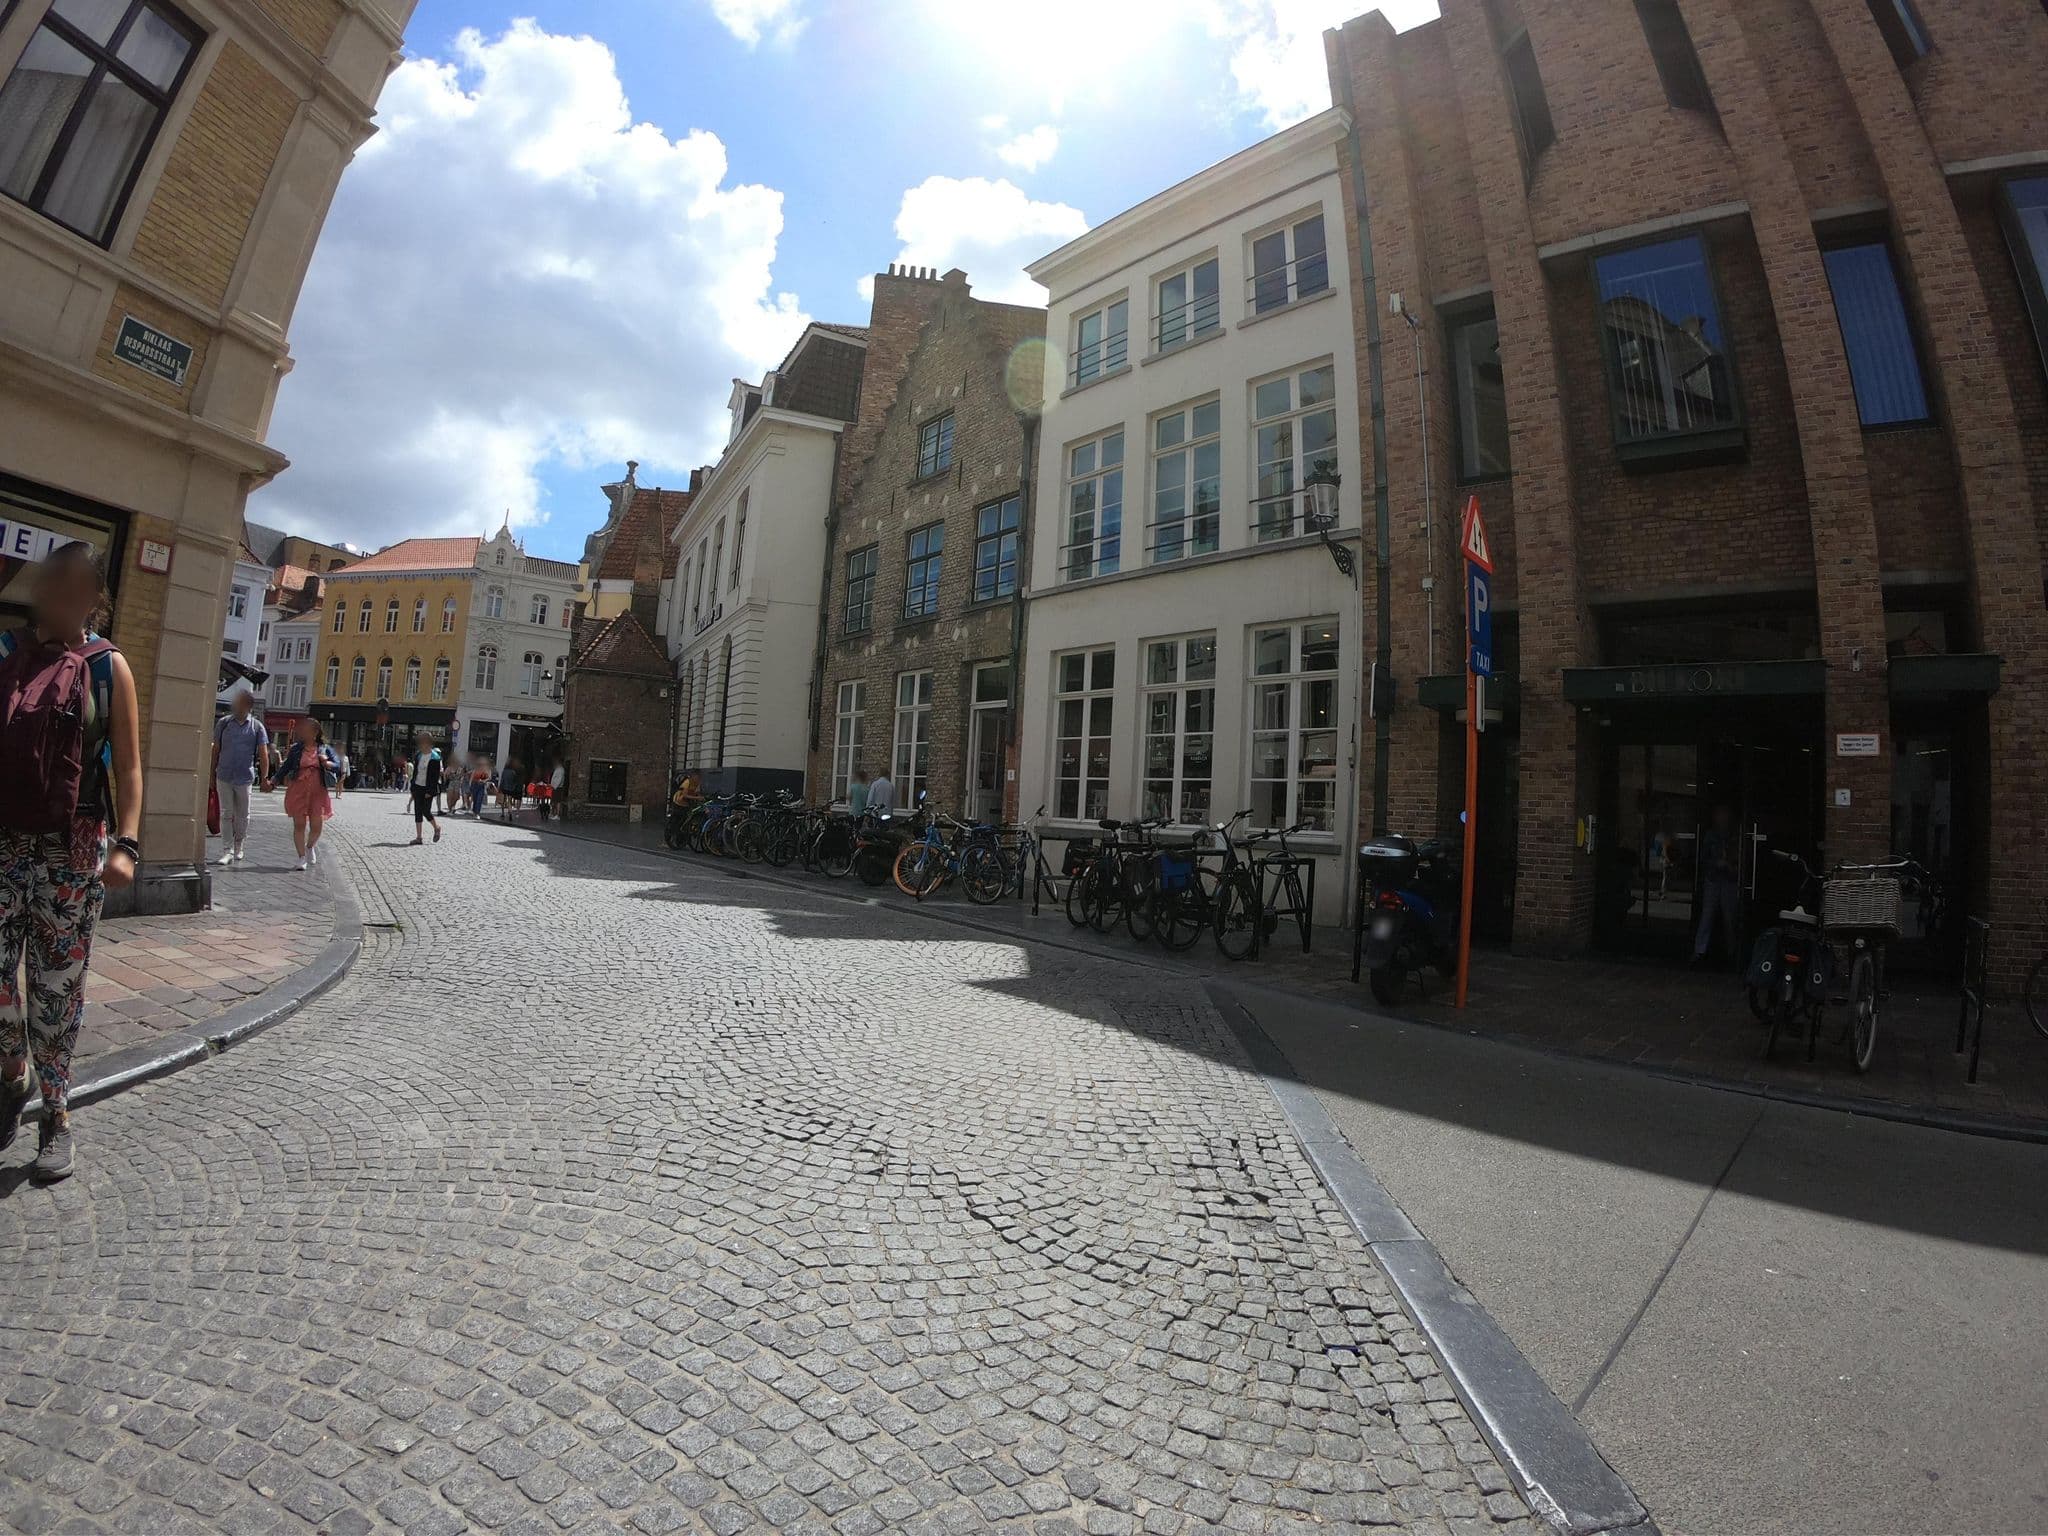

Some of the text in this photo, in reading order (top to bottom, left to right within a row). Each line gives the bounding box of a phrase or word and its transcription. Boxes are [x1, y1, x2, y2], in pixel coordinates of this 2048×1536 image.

[124, 336, 181, 368] DESPARSSTRAAT
[143, 331, 173, 352] NIKLAAS
[1473, 575, 1488, 633] P
[1476, 651, 1490, 672] TAXI
